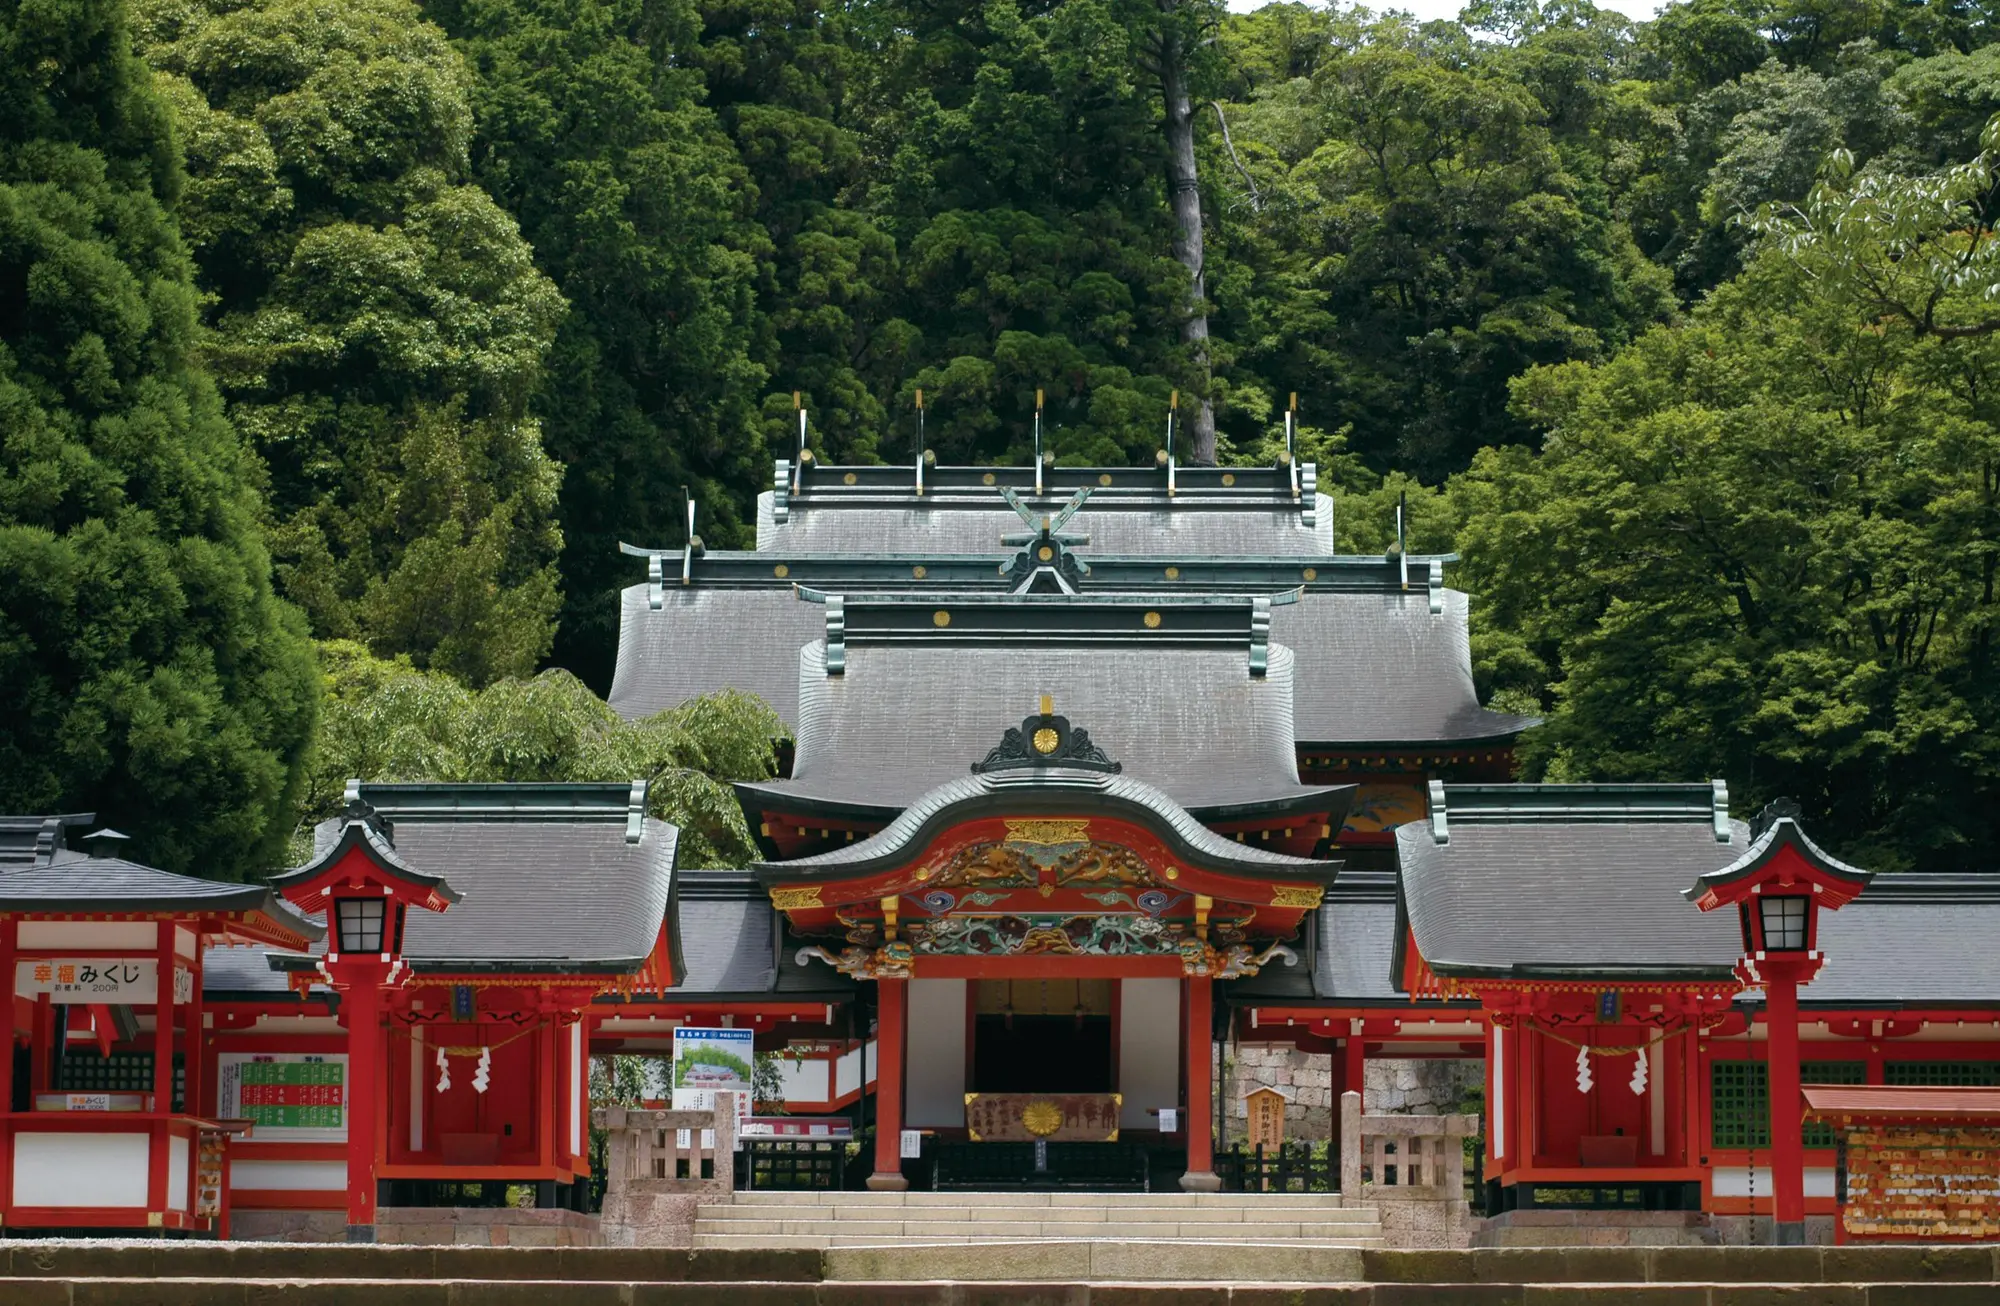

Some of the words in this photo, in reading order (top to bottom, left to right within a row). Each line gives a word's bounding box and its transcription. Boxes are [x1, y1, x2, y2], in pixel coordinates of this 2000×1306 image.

[34, 964, 140, 984] 幸福みくじ
[92, 984, 119, 993] 200円
